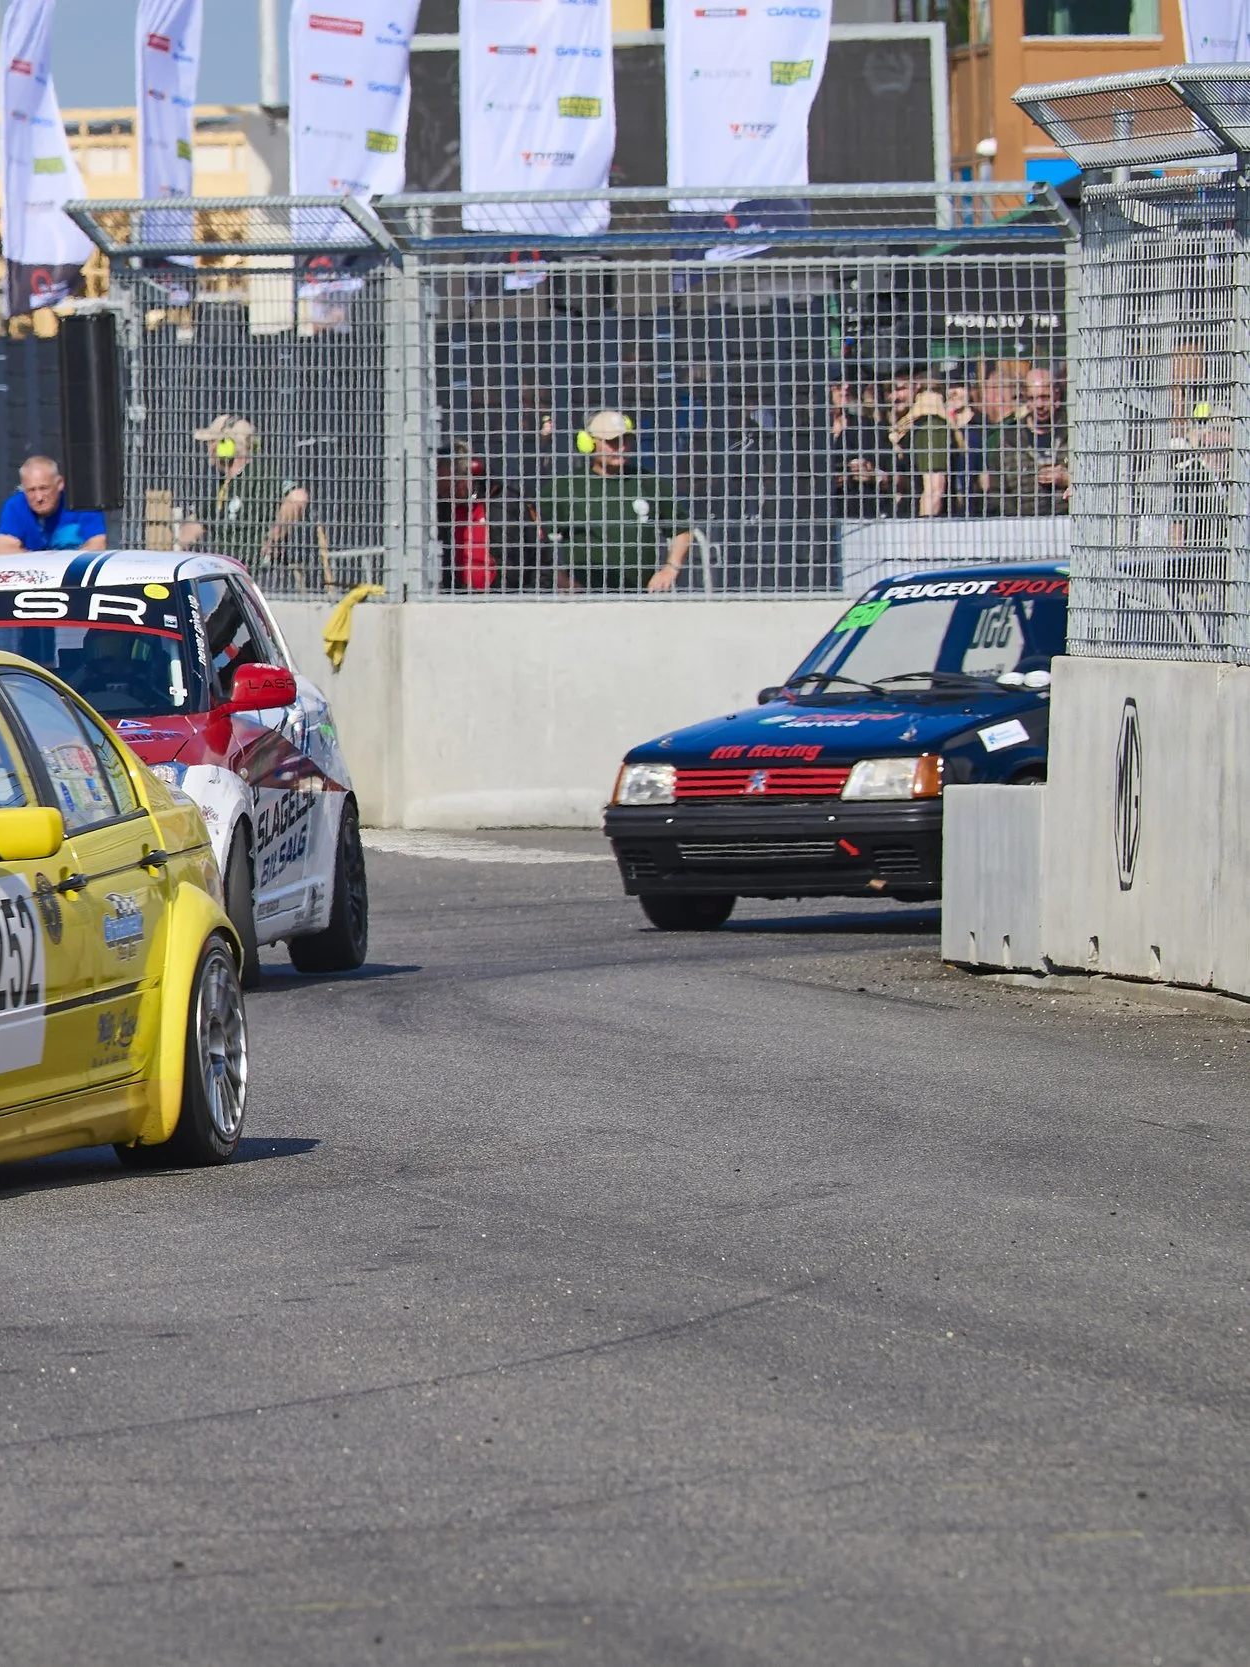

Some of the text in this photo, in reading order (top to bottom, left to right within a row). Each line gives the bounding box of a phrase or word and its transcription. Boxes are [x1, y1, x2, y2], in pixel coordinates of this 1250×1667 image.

[1029, 314, 1060, 328] THE
[880, 579, 998, 600] PEUGEOT
[187, 594, 200, 611] up
[196, 632, 207, 667] never
[747, 744, 824, 761] Racing
